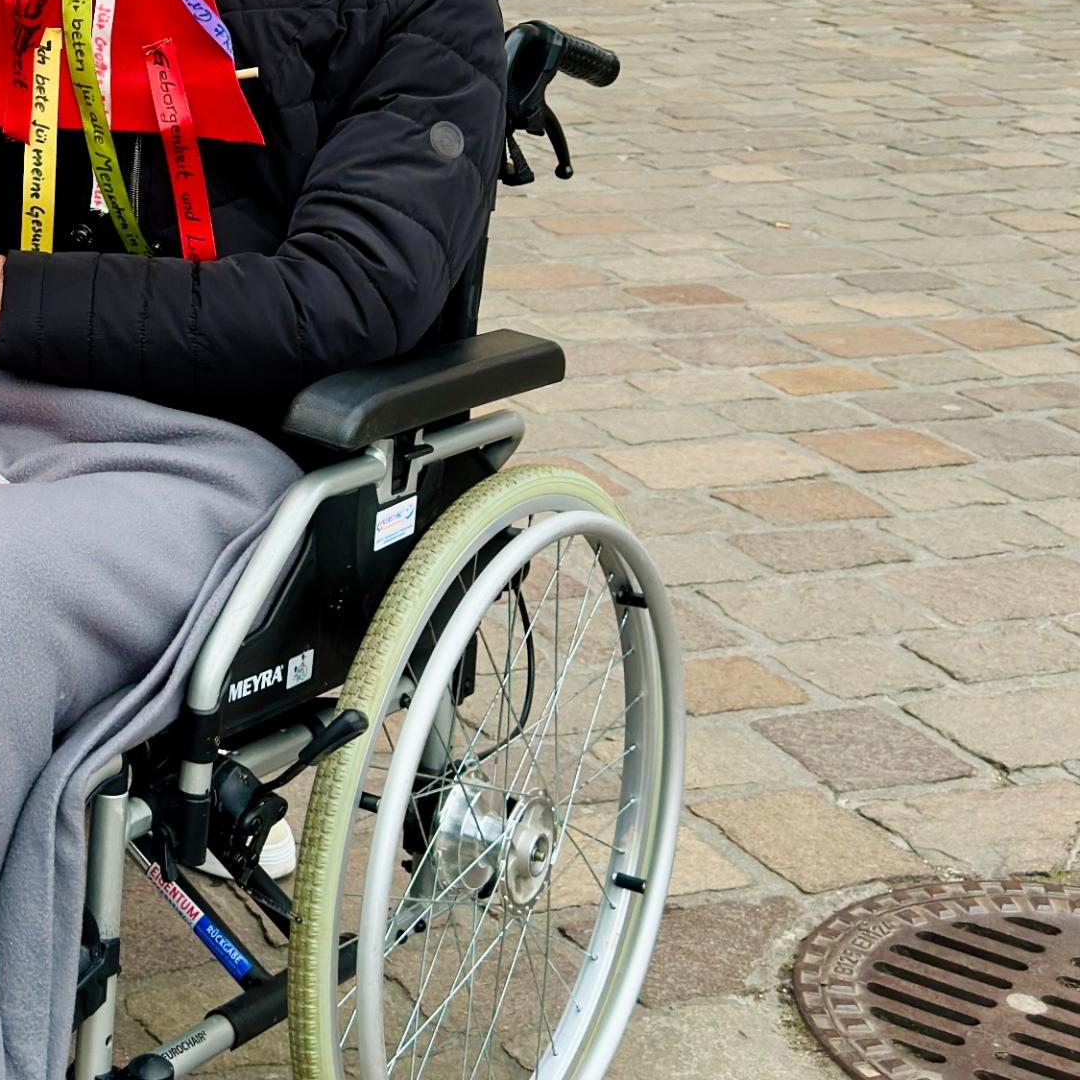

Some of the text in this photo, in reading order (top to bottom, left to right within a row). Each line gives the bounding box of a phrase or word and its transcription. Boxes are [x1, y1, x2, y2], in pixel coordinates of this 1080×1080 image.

[34, 74, 50, 113] bete
[90, 111, 105, 145] alle
[152, 49, 194, 180] Geborgenheit
[180, 192, 201, 223] und
[29, 148, 46, 199] meine
[227, 666, 283, 703] MEYRA
[205, 924, 242, 966] RÜCKGABE
